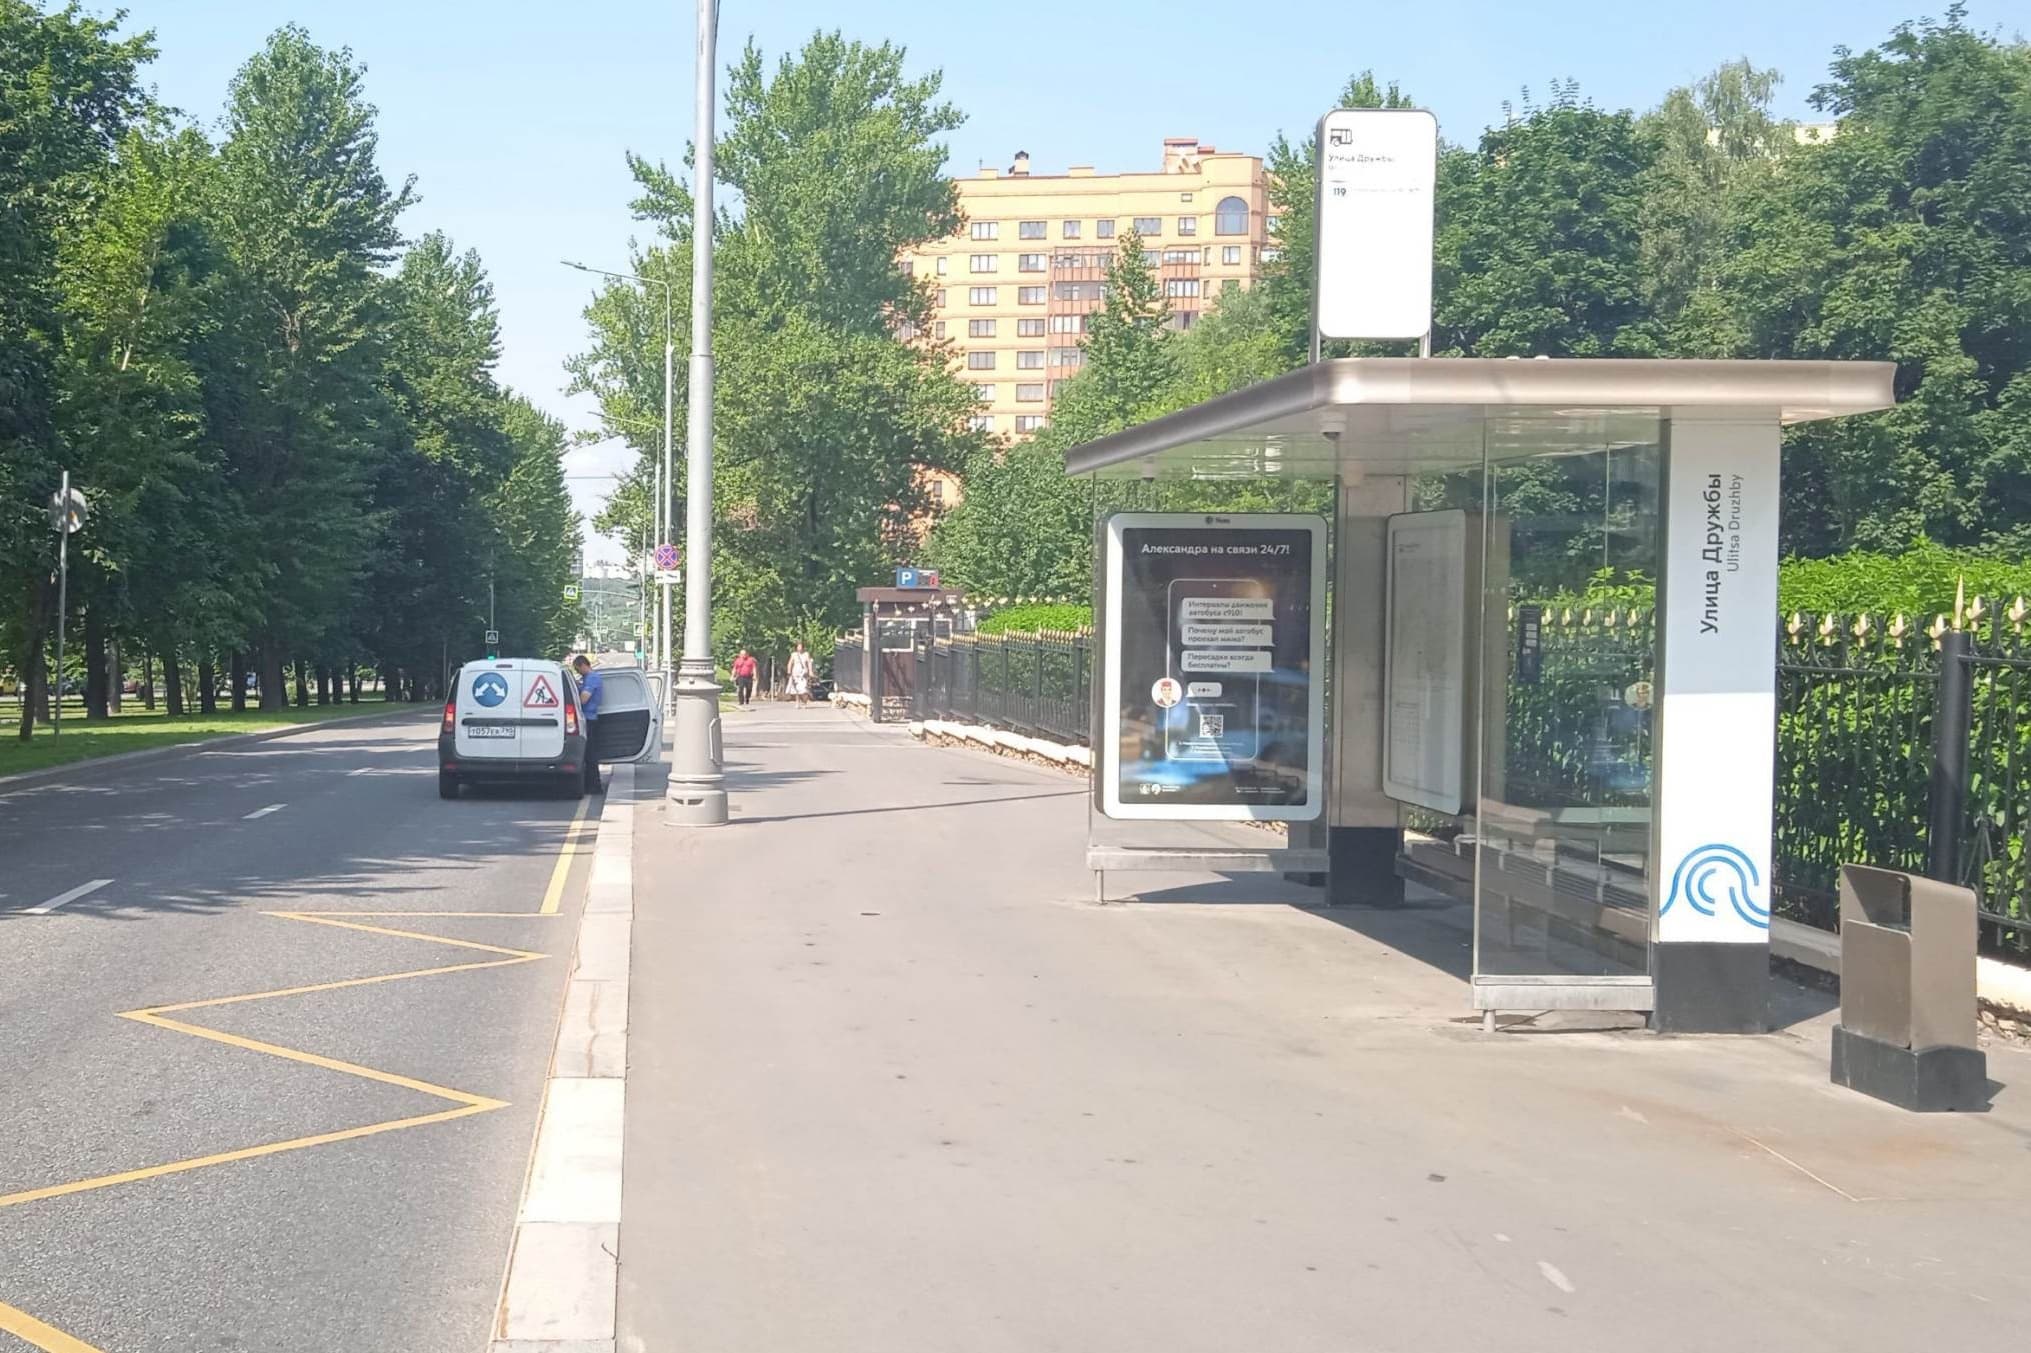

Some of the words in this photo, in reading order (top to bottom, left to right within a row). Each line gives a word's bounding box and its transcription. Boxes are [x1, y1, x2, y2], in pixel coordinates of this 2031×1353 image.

[1333, 187, 1347, 197] 119
[1728, 474, 1744, 530] Druzhby
[1702, 473, 1724, 564] Дружбы
[1141, 543, 1208, 556] Александра
[1210, 545, 1224, 554] на
[1227, 545, 1258, 554] связи
[1260, 544, 1290, 555] 24/7!
[1727, 536, 1740, 572] Ulitsa
[901, 571, 913, 585] P
[1700, 570, 1721, 634] Улица
[1188, 609, 1222, 617] автобуса
[1188, 626, 1217, 636] Почему
[1230, 654, 1254, 662] всегда
